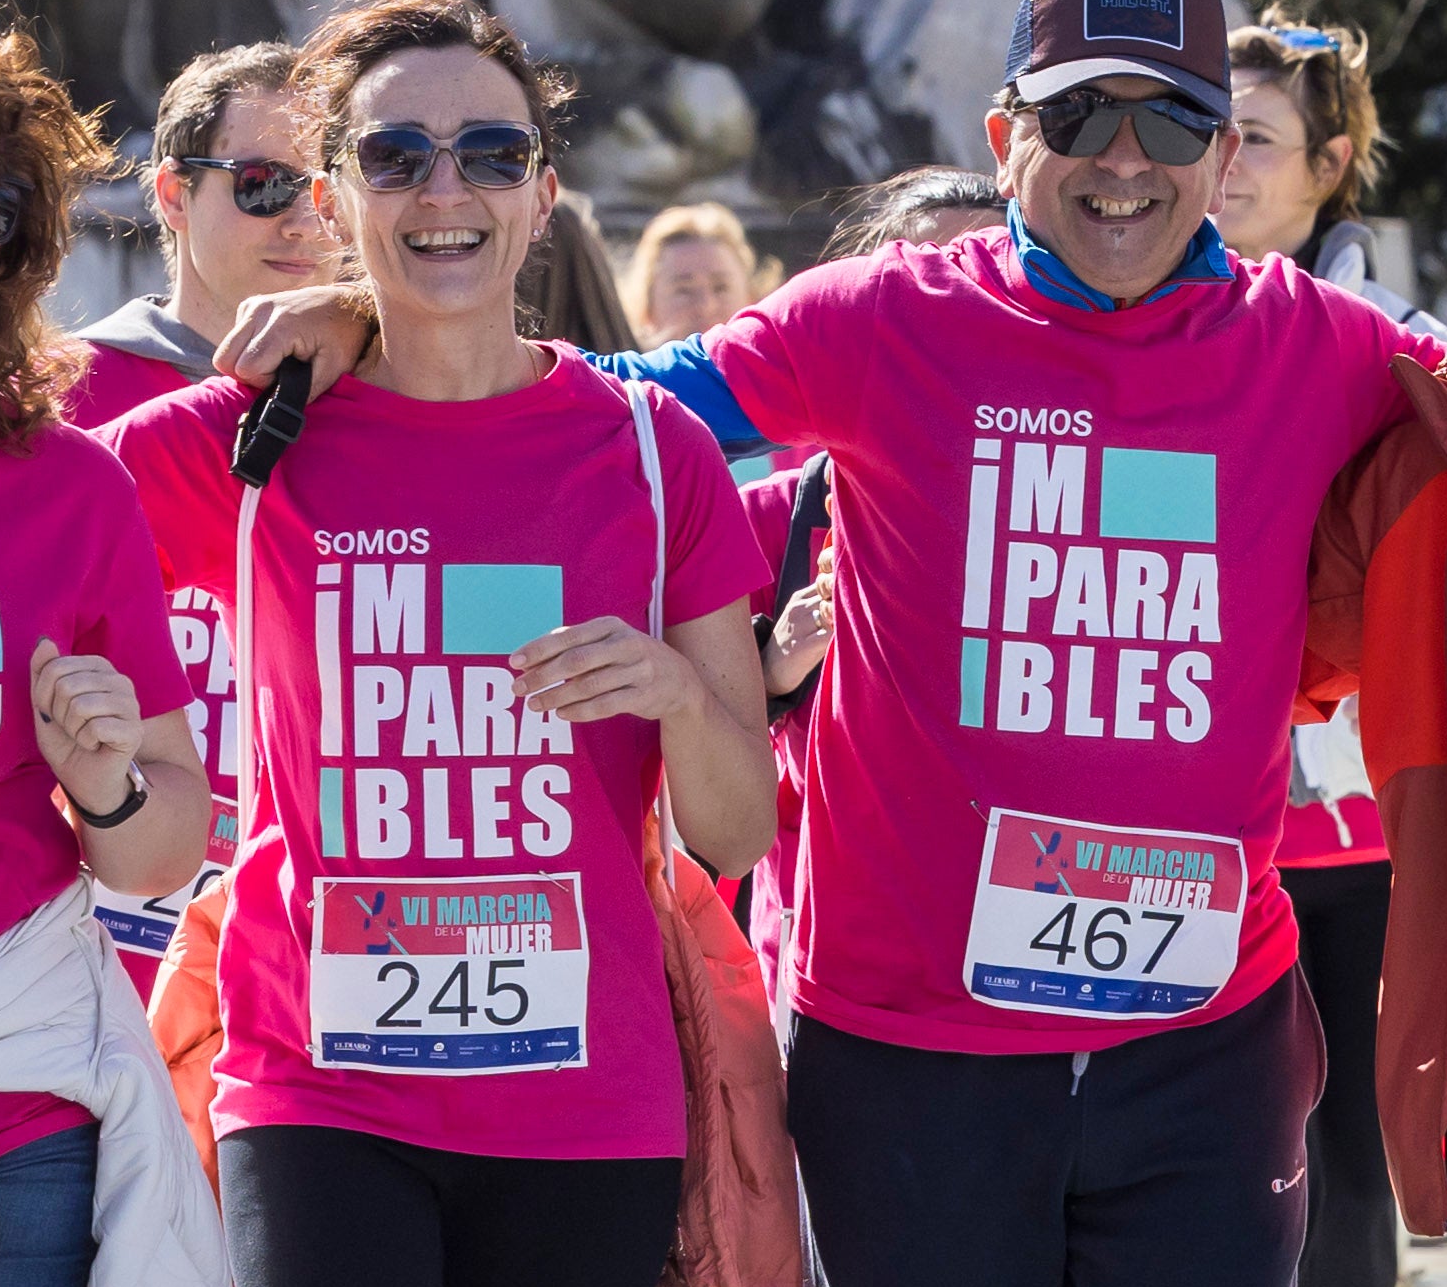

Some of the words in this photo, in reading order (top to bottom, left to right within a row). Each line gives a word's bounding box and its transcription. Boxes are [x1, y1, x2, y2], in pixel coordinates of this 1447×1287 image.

[974, 404, 1093, 437] SOMOS
[314, 527, 430, 556] SOMOS
[1003, 541, 1222, 642] PARA
[1075, 839, 1103, 872] VI
[1106, 843, 1216, 882] MARCHA
[401, 896, 430, 926] VI
[437, 893, 552, 926] MARCHA
[1102, 873, 1116, 883] DE
[1117, 875, 1129, 885] LA
[1127, 875, 1211, 911] MUJER
[434, 927, 449, 936] DE
[450, 927, 464, 936] LA
[466, 924, 553, 955] MUJER
[1029, 902, 1185, 974] 467
[375, 960, 530, 1028] 245
